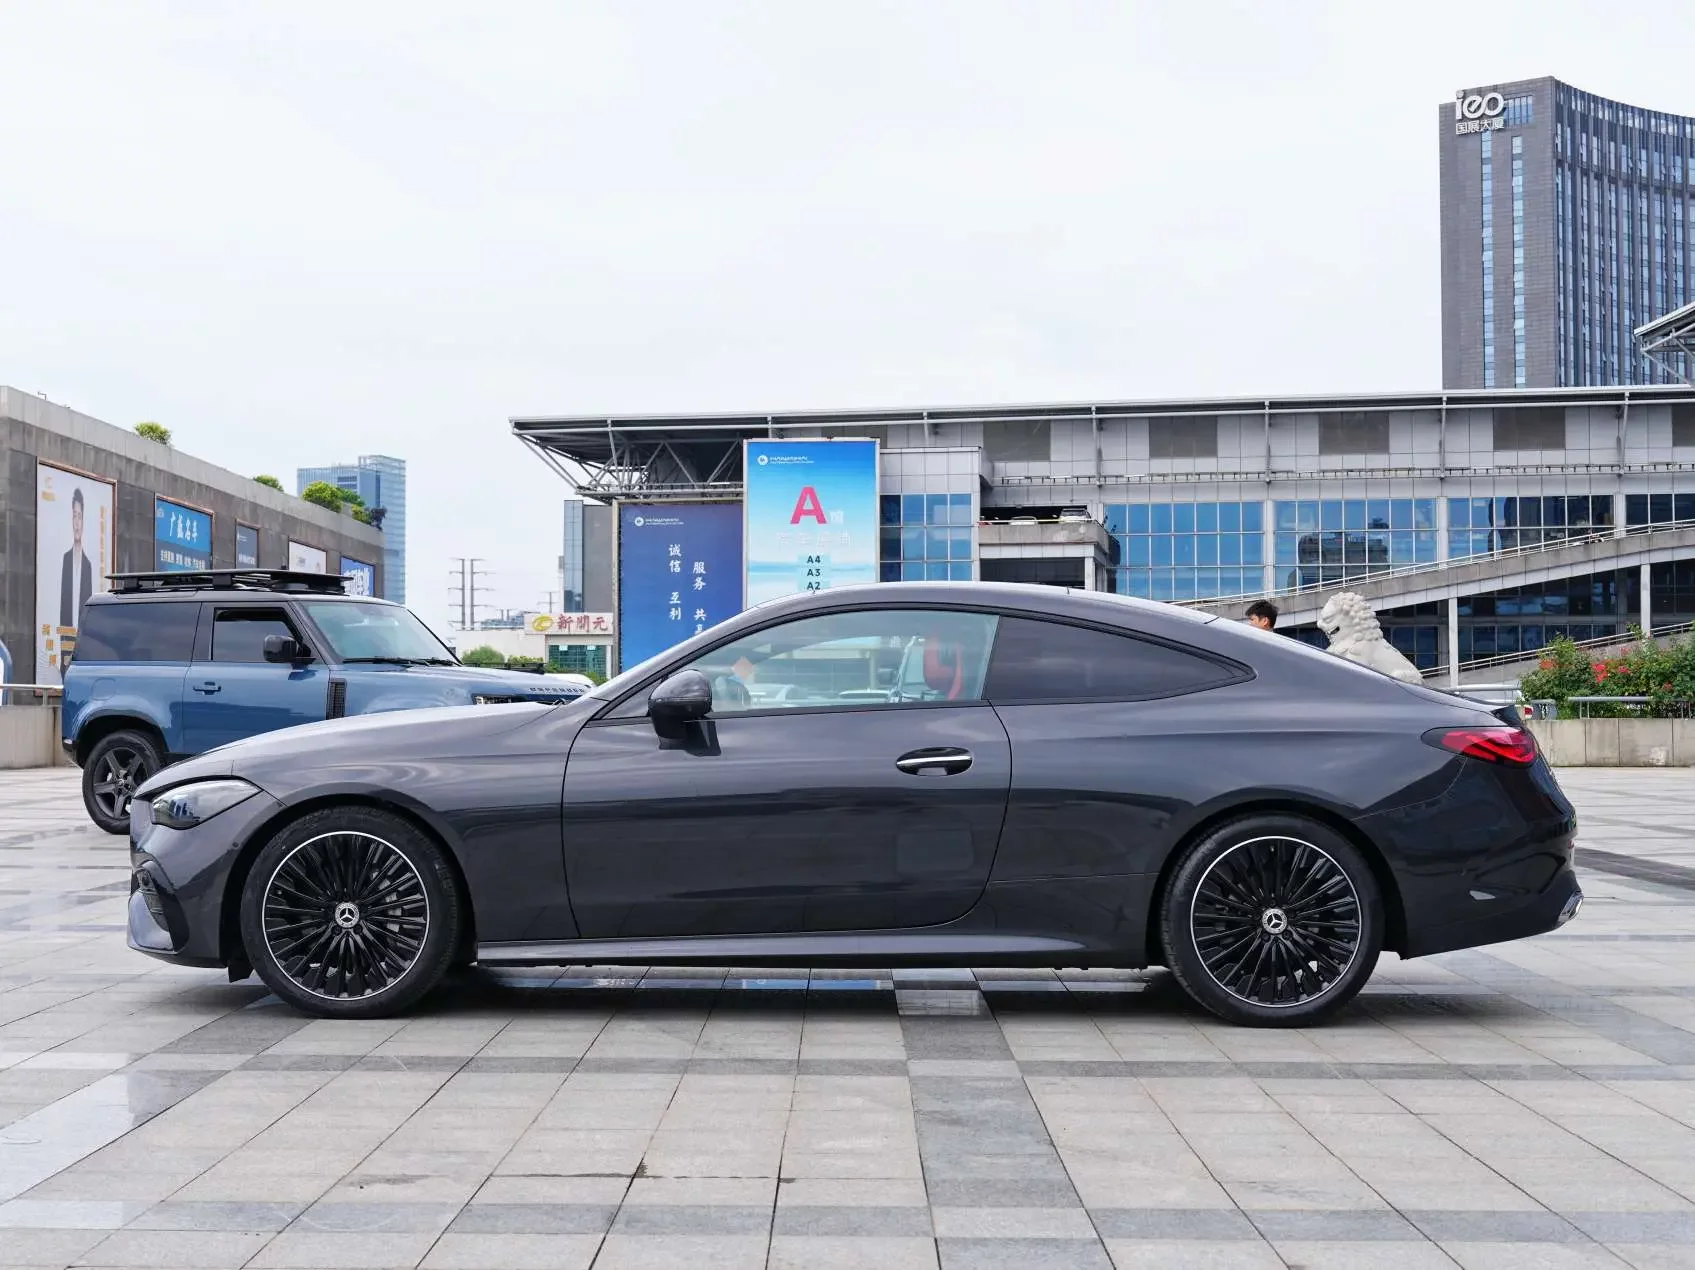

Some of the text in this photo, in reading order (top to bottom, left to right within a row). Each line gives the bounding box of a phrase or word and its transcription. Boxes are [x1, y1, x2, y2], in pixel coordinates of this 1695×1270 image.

[1456, 117, 1504, 134] 国展大厦
[807, 555, 821, 563] A4
[693, 561, 706, 590] 服务
[807, 568, 821, 577] A3
[668, 544, 682, 620] 诚信 互利
[807, 581, 821, 590] A2
